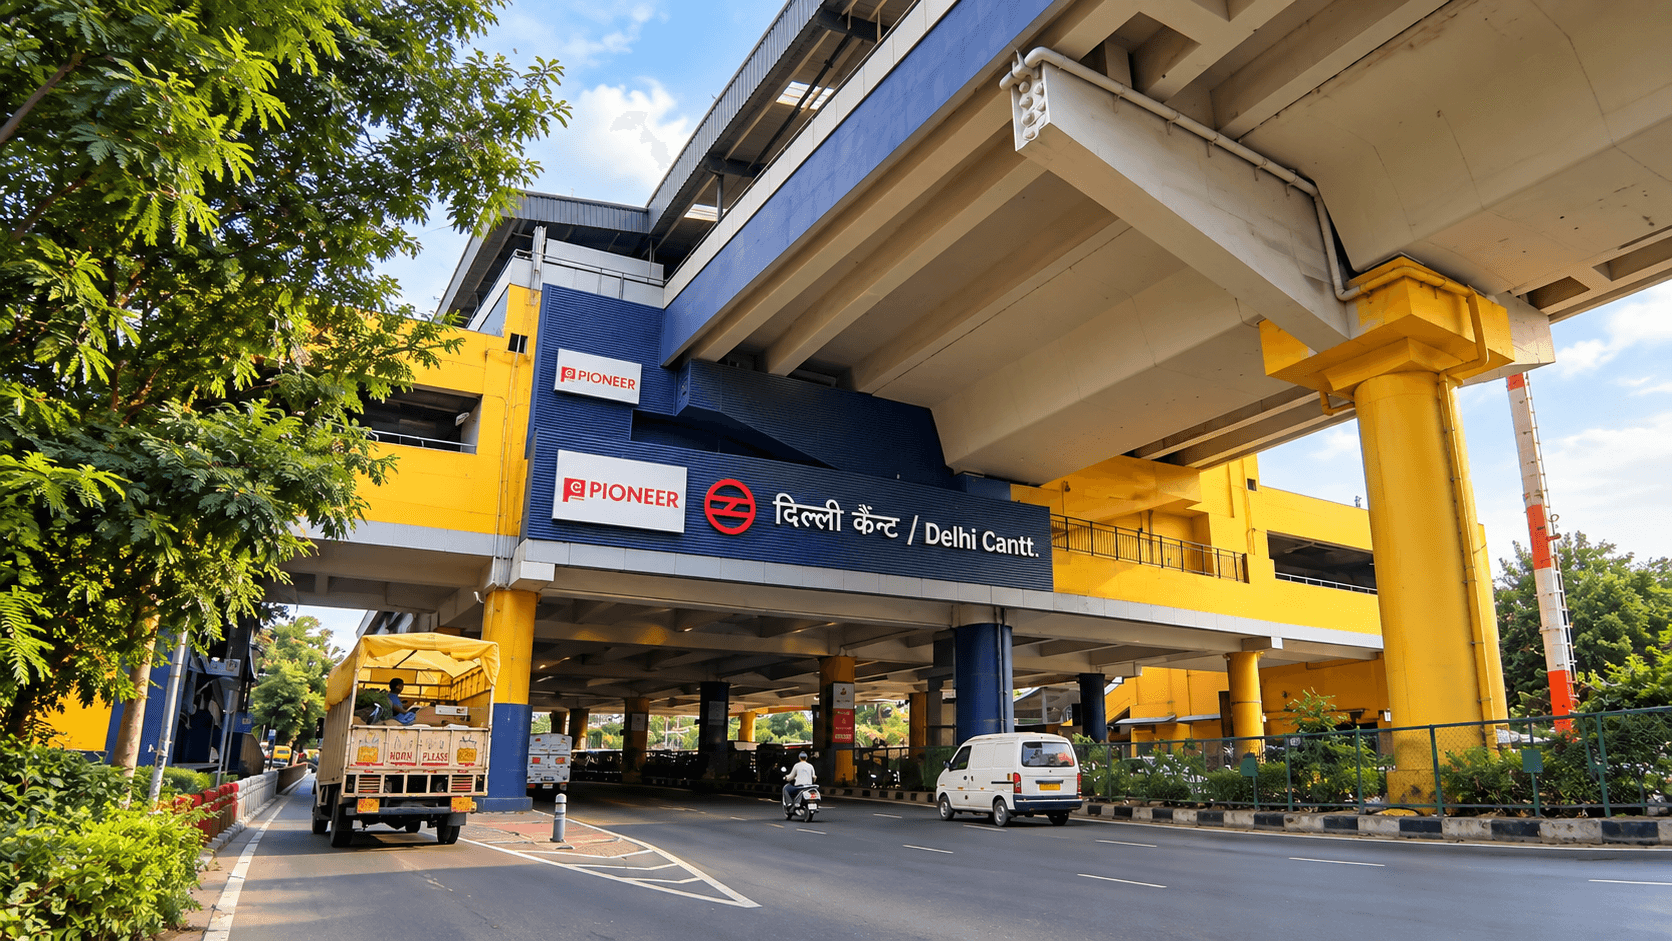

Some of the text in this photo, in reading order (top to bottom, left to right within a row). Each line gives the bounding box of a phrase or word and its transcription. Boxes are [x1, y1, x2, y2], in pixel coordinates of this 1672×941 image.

[578, 370, 637, 390] PIONEER
[589, 481, 680, 509] PIONEER
[772, 492, 845, 532] दिल्ली
[925, 522, 977, 551] Delhi
[982, 530, 1039, 558] Cantt.
